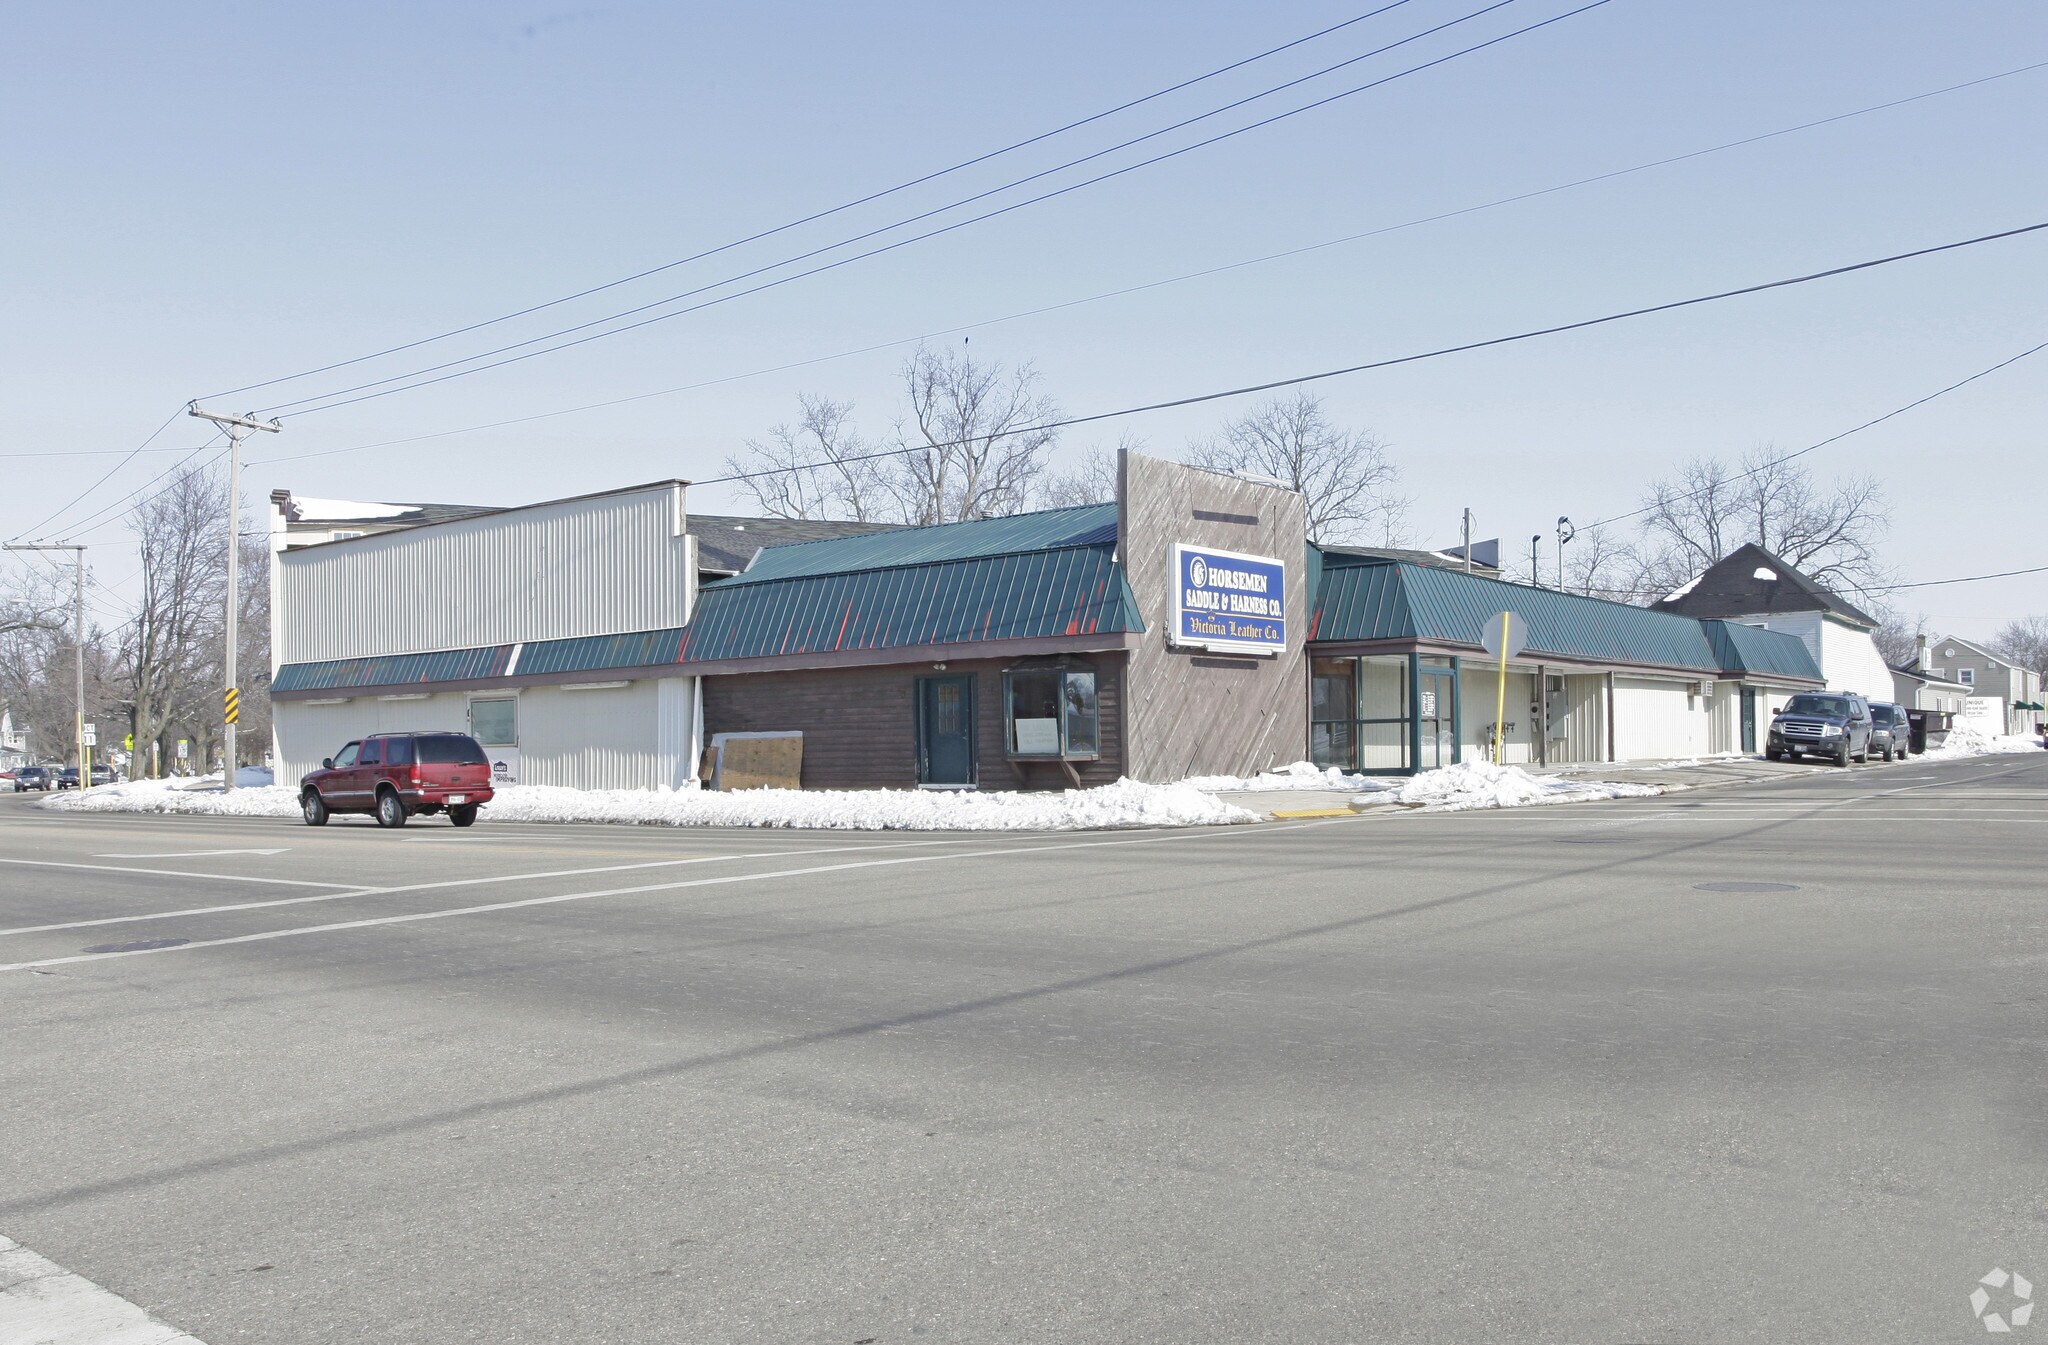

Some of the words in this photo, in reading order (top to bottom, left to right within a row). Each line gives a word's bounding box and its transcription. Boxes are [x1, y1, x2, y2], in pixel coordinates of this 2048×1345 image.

[1209, 568, 1267, 593] HORSEMEN
[1186, 589, 1219, 610] SADDLE
[1221, 593, 1228, 611] &
[1230, 594, 1267, 615] HARNESS
[1269, 599, 1282, 616] CO.
[1190, 617, 1226, 635] Victoria
[1229, 621, 1263, 640] Leather
[1264, 625, 1279, 639] Co.
